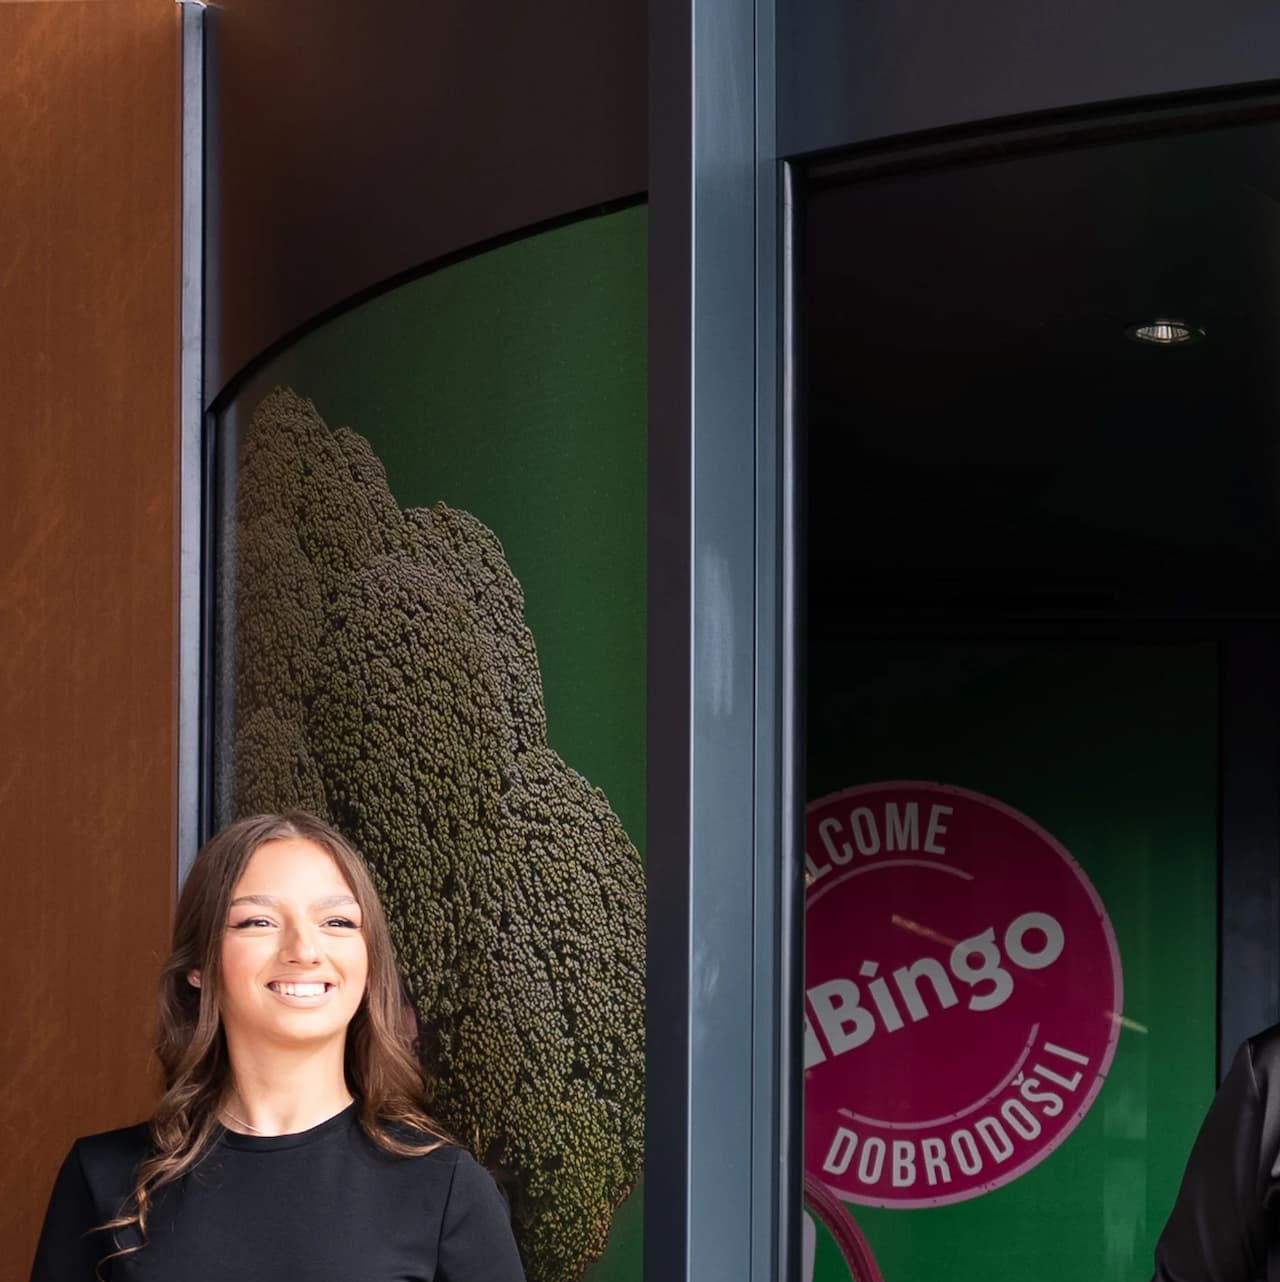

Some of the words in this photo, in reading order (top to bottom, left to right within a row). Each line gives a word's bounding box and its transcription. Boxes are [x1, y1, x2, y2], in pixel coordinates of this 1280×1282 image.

[804, 802, 953, 881] LCOME
[806, 912, 1065, 1056] Bingo
[822, 1042, 1090, 1187] DOBRODOŠLI
